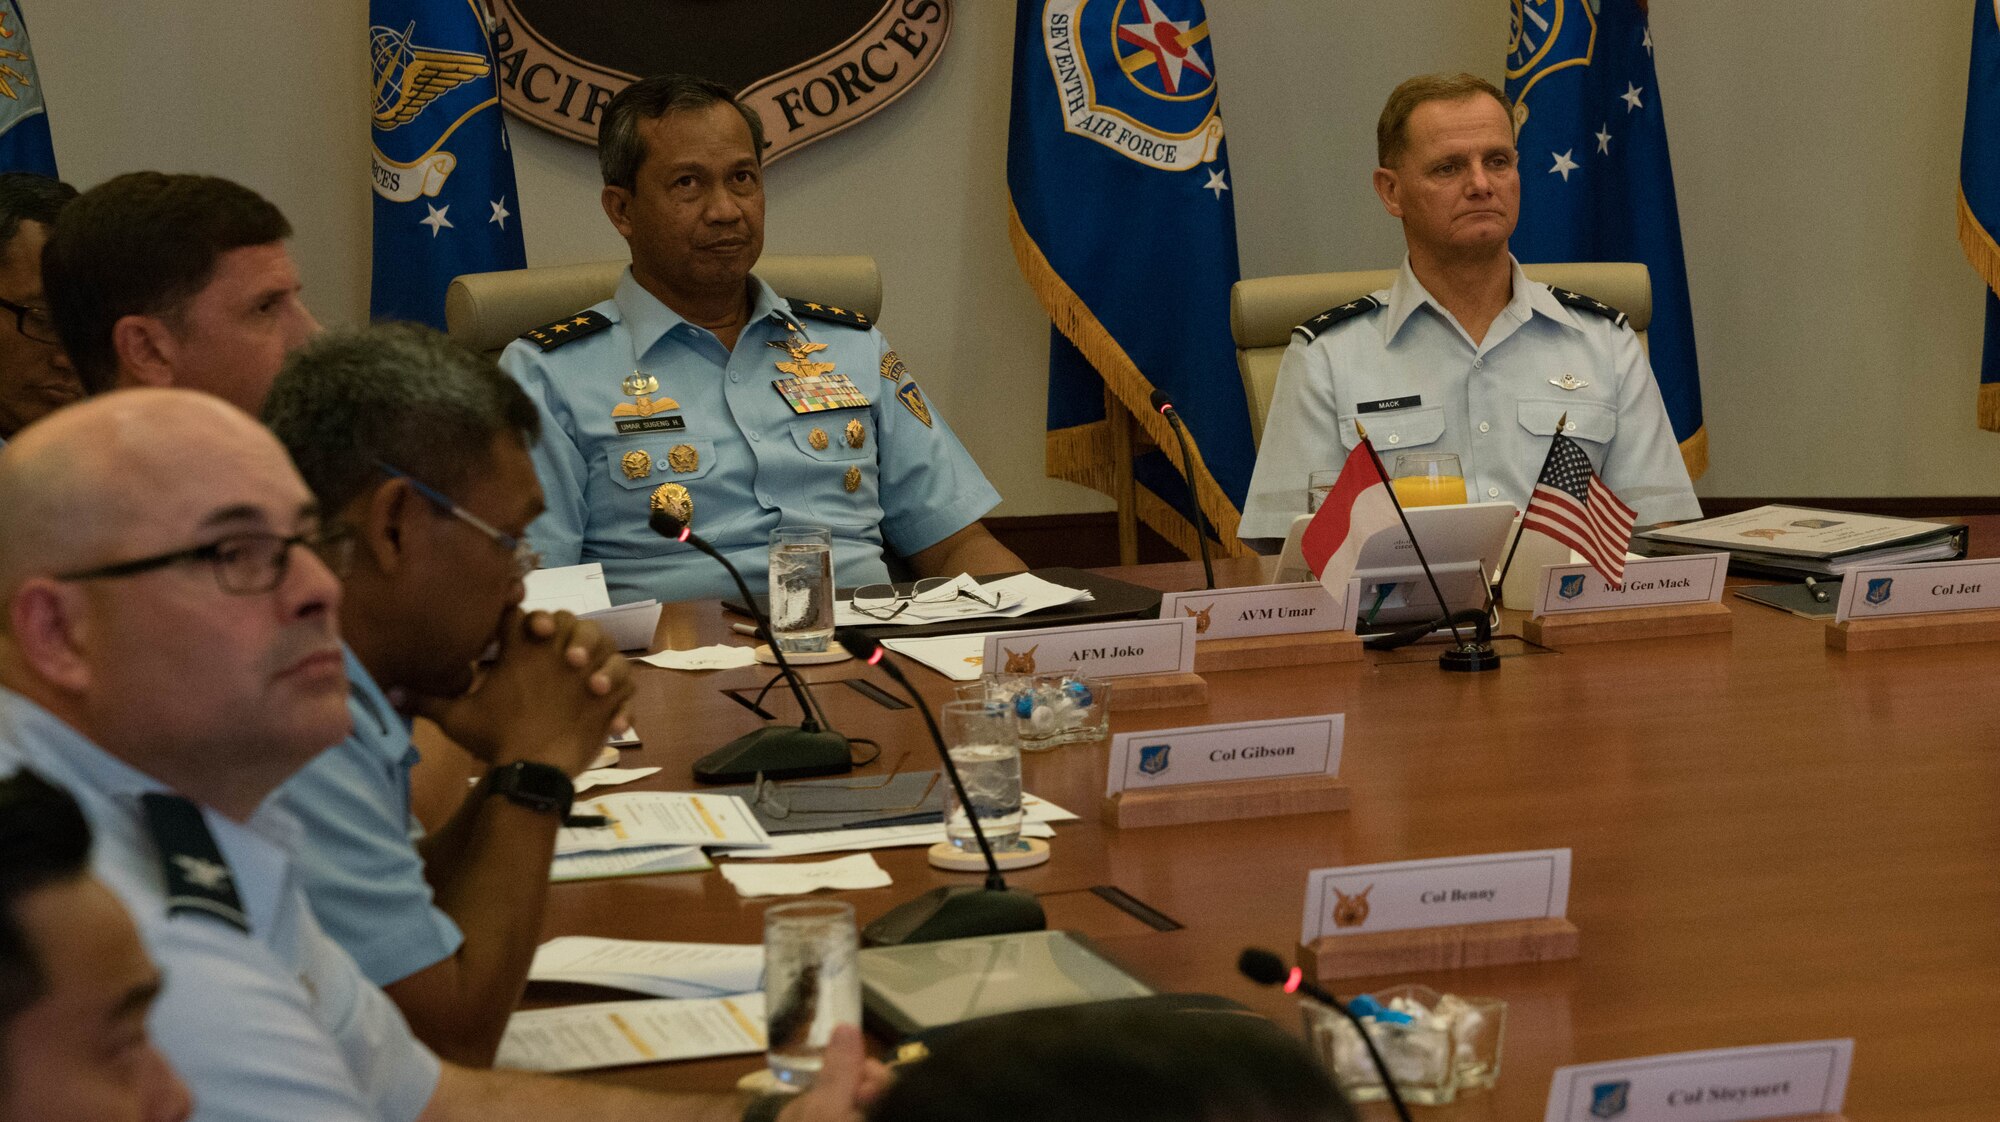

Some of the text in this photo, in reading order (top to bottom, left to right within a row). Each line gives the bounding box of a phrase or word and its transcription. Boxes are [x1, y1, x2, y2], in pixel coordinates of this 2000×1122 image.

[489, 0, 942, 132] PACIF FORCES
[1051, 13, 1177, 164] SEVENTH AIR FORCE
[1378, 400, 1400, 409] MACK
[643, 420, 670, 429] SUGENG
[1630, 580, 1654, 591] Gen
[1658, 577, 1690, 589] Mack
[1931, 583, 1982, 596] Col Jett
[1238, 607, 1316, 621] AVM Umar
[1069, 645, 1144, 662] AFM Joko
[1209, 746, 1295, 762] Col Gibson
[1420, 889, 1495, 904] Col Benny
[1667, 1088, 1703, 1106] Col
